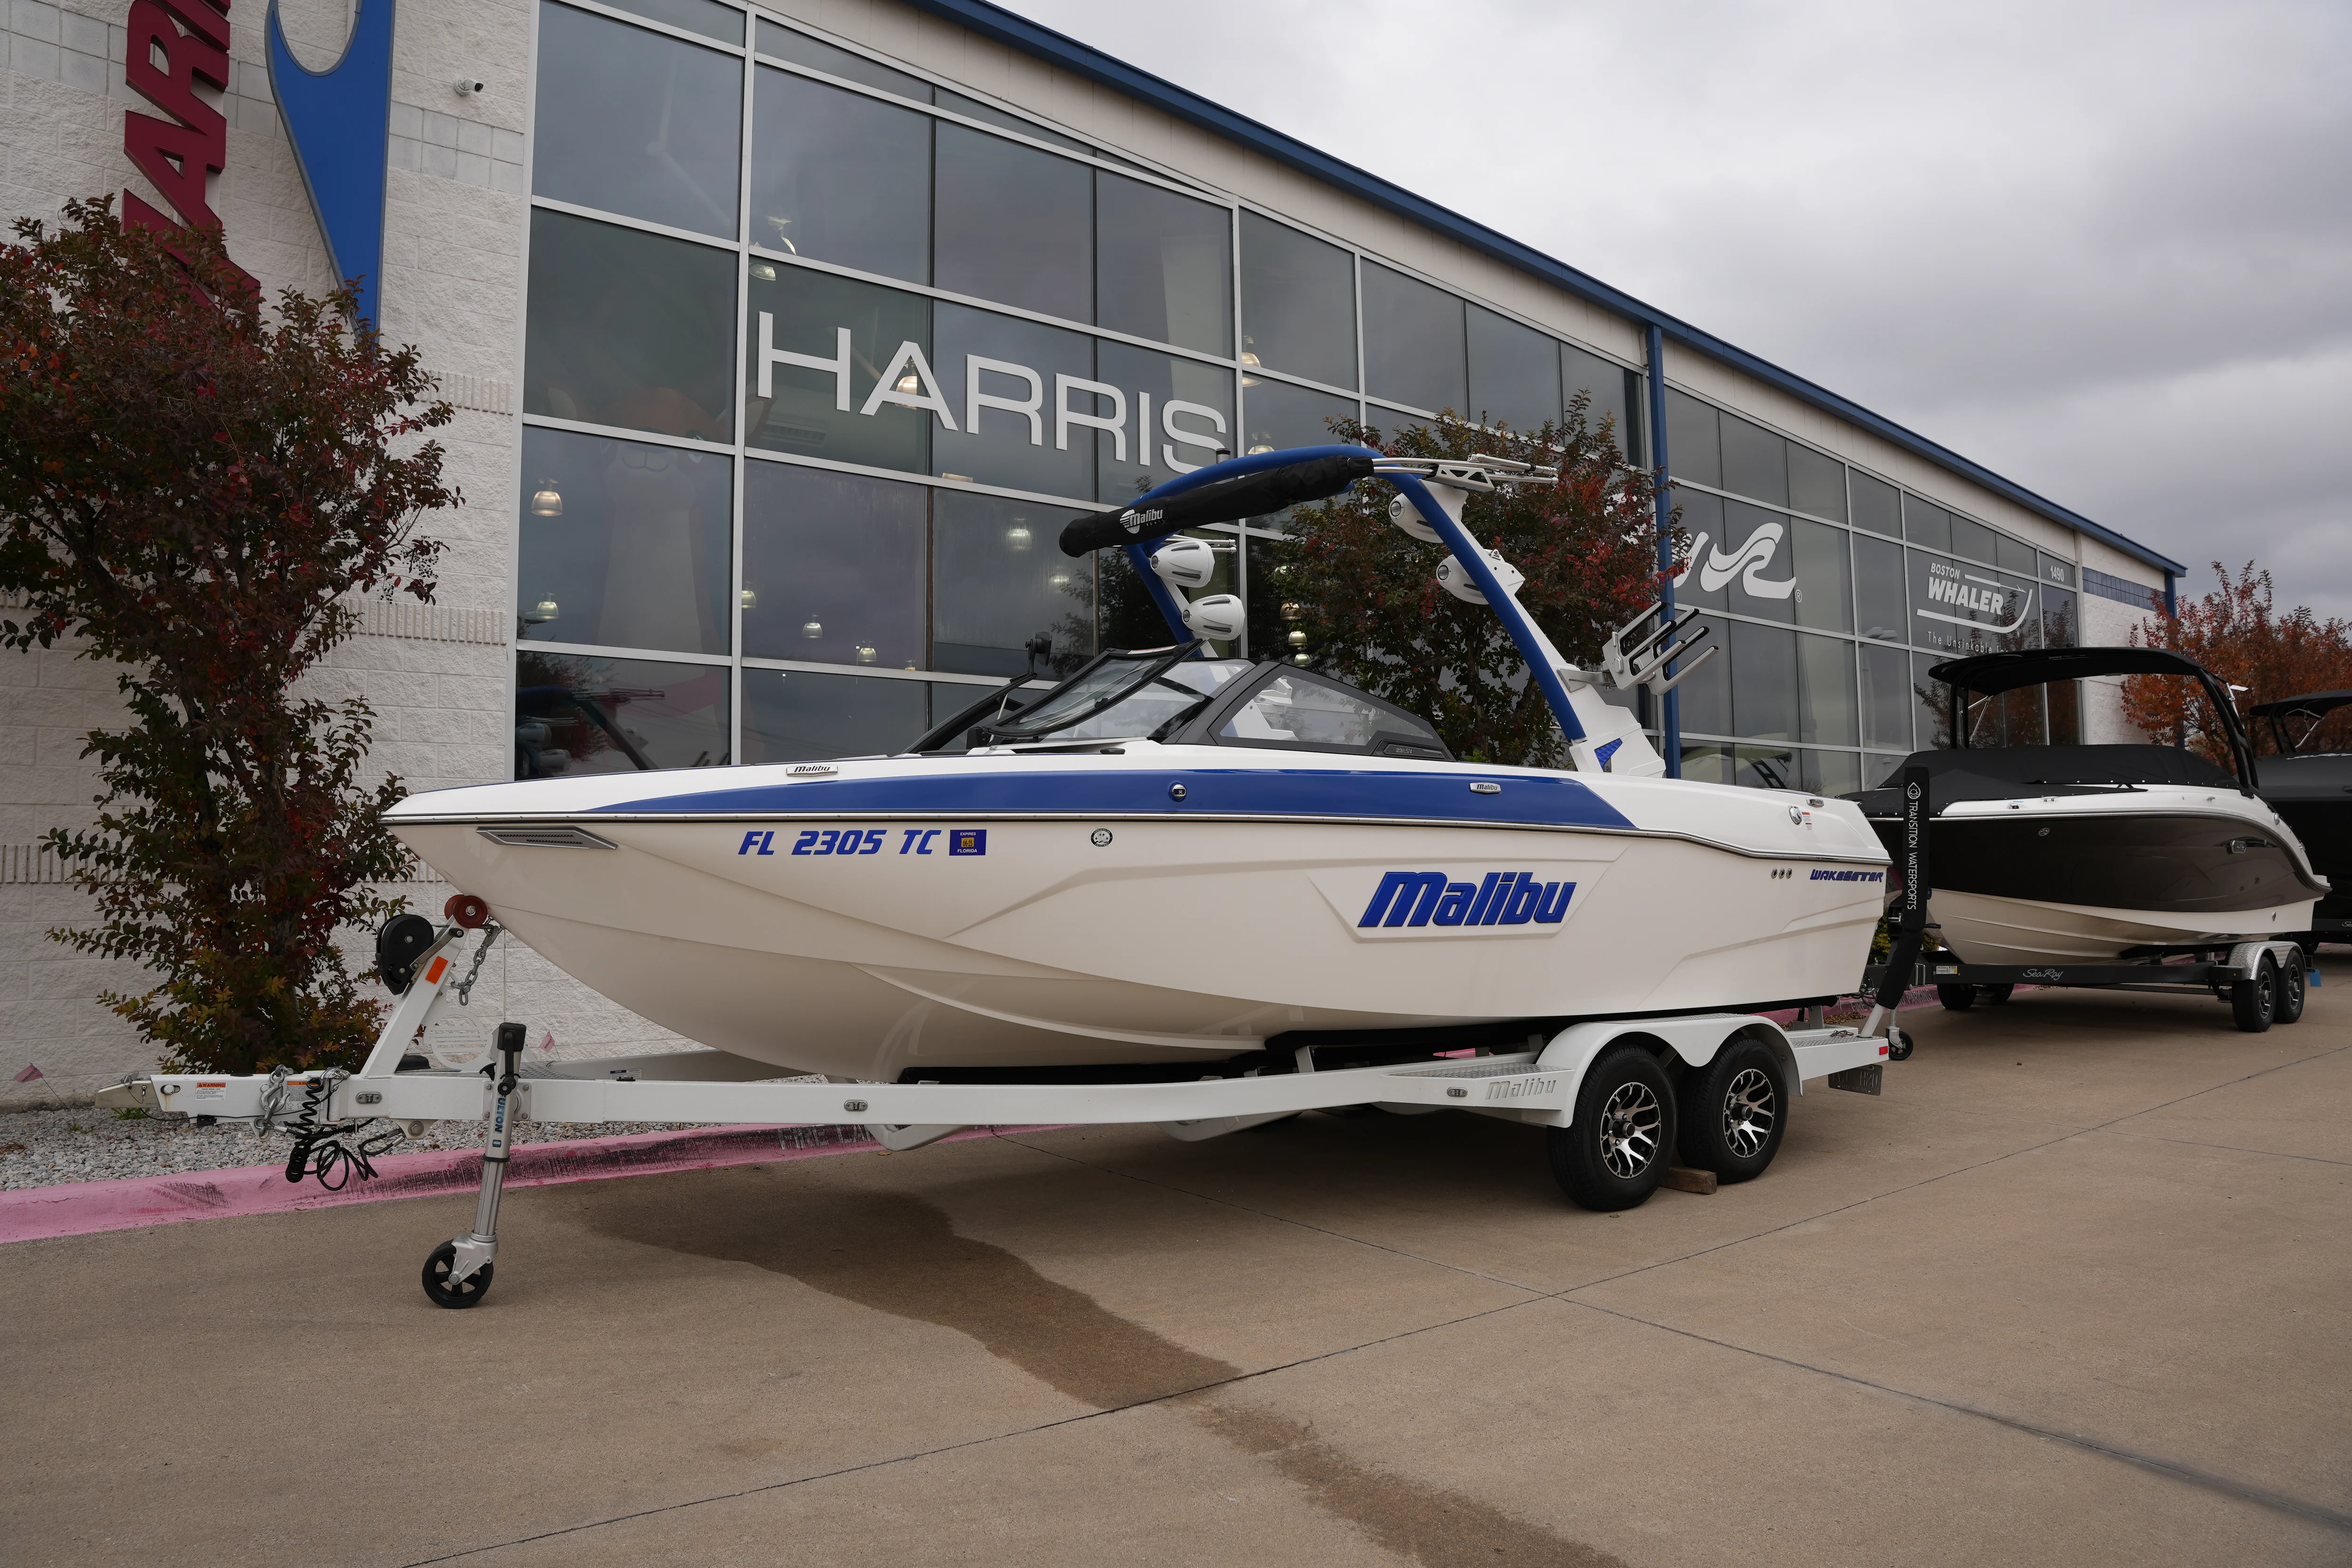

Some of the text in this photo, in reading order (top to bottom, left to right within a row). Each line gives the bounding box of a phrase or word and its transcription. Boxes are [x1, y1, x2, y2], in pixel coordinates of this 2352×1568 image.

[758, 311, 1226, 474] HARRIS
[1931, 563, 1960, 579] BOSTON
[2050, 565, 2064, 582] 1490
[1928, 576, 2003, 615] WHALER
[1928, 631, 1942, 645] The
[1947, 635, 1992, 654] Unsinkable
[738, 829, 942, 855] FL 2305 TC
[1907, 801, 1918, 910] TRANSITION WATERSPORTS
[2023, 969, 2064, 980] Sea Ray
